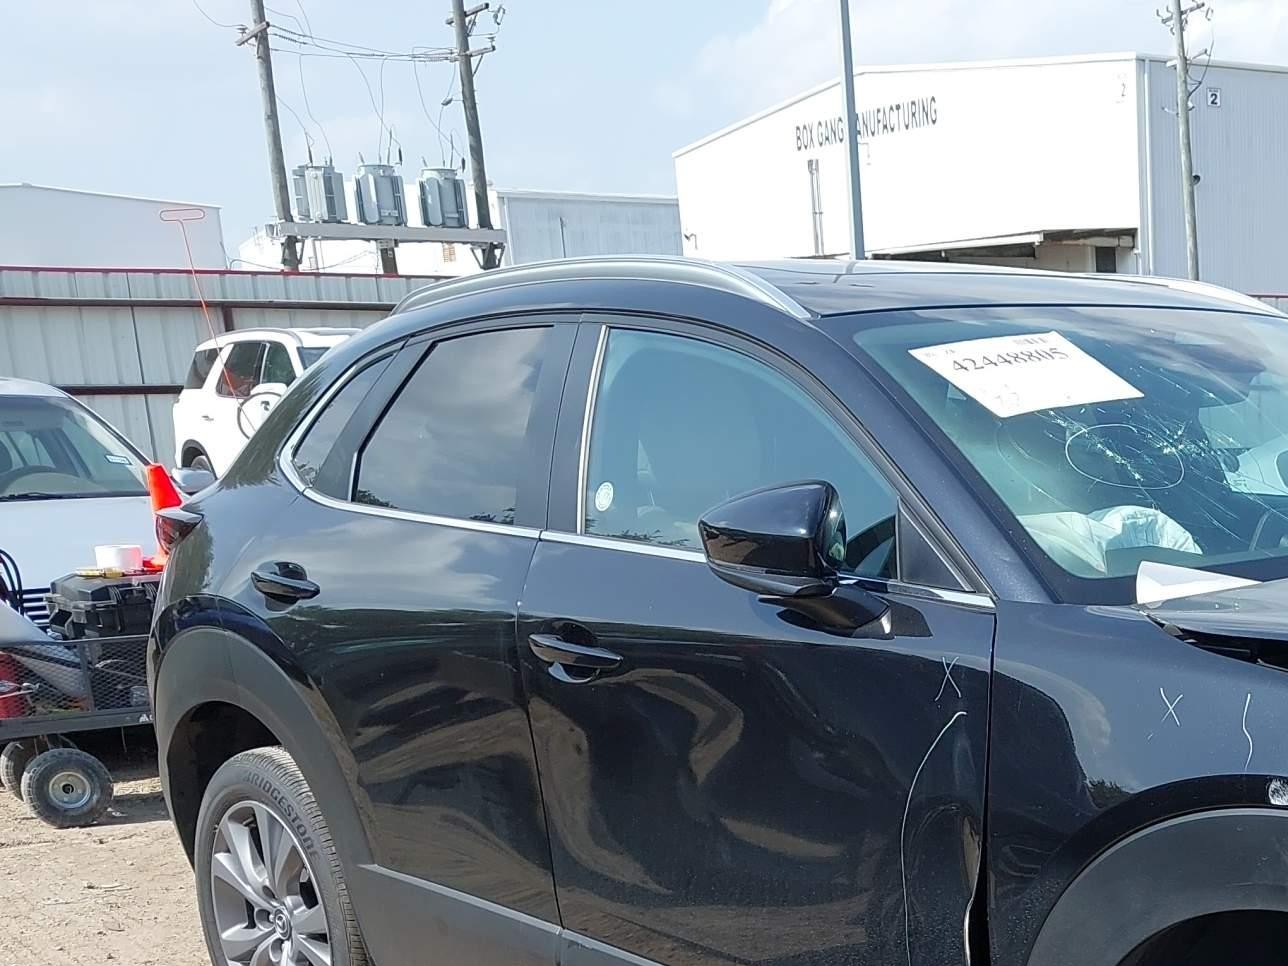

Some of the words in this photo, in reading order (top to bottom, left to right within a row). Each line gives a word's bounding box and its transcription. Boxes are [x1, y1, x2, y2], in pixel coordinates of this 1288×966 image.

[1210, 93, 1218, 105] 2
[796, 122, 815, 151] BOX
[817, 116, 845, 147] GANG
[855, 96, 938, 139] ANUFACTURING
[952, 347, 1069, 373] 42448805
